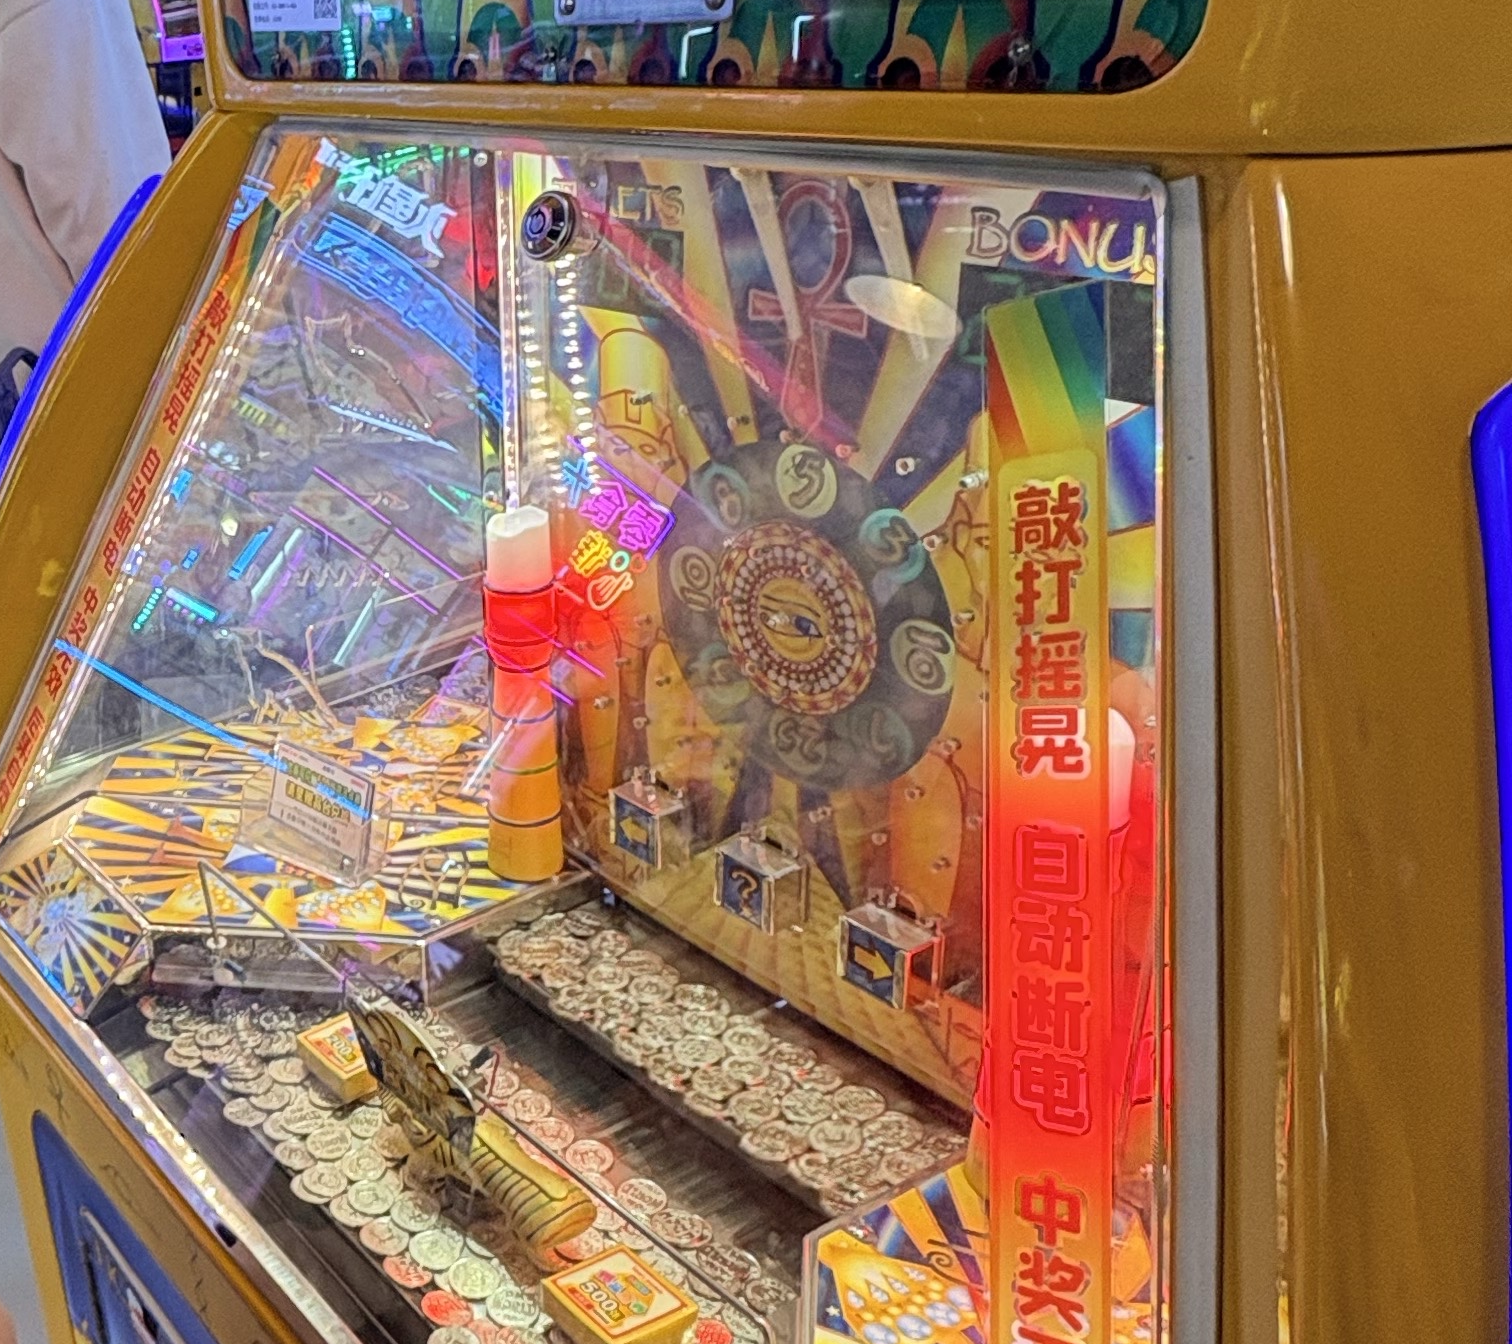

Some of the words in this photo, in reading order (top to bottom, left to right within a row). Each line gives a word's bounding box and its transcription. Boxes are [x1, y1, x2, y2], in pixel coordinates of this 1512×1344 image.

[1011, 479, 1086, 777] 敲打摇晃
[1016, 826, 1087, 1131] 自动断电
[579, 1279, 619, 1312] 500
